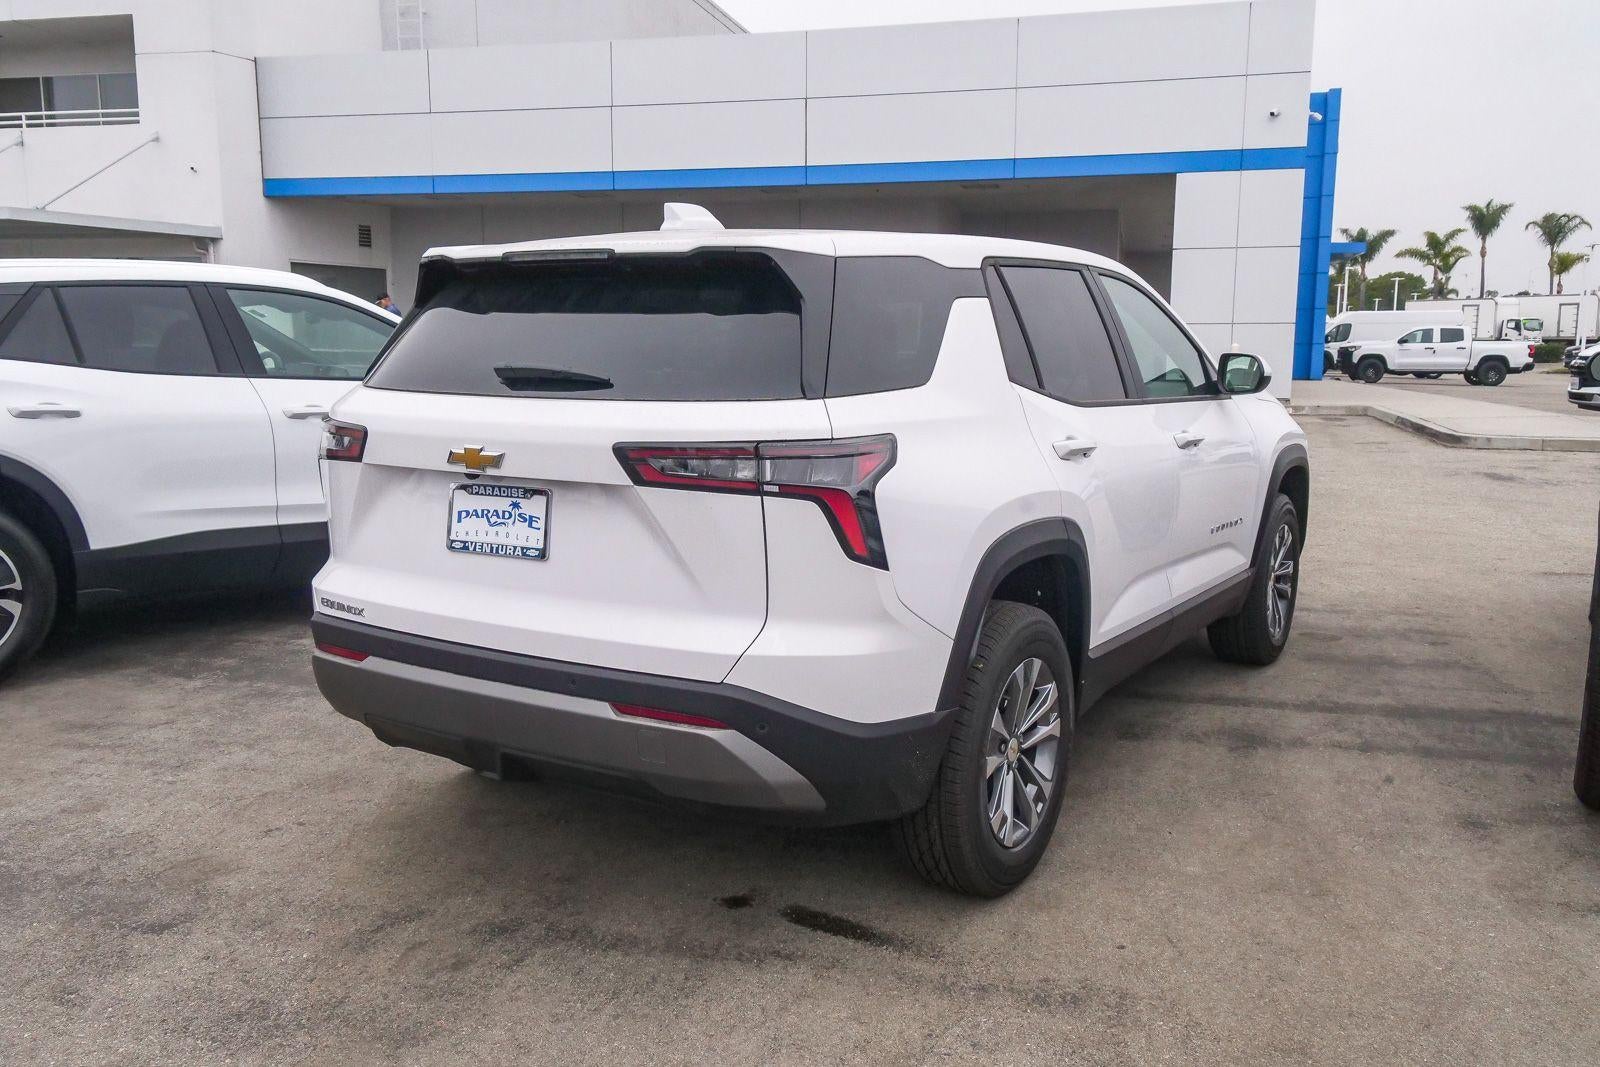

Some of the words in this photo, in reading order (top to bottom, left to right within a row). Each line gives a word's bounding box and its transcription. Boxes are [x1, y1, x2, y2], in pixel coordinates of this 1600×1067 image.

[472, 485, 525, 498] PARADISE
[457, 500, 541, 531] PARADISE
[455, 530, 540, 545] CHEVROLET
[320, 597, 366, 617] EQUINOX
